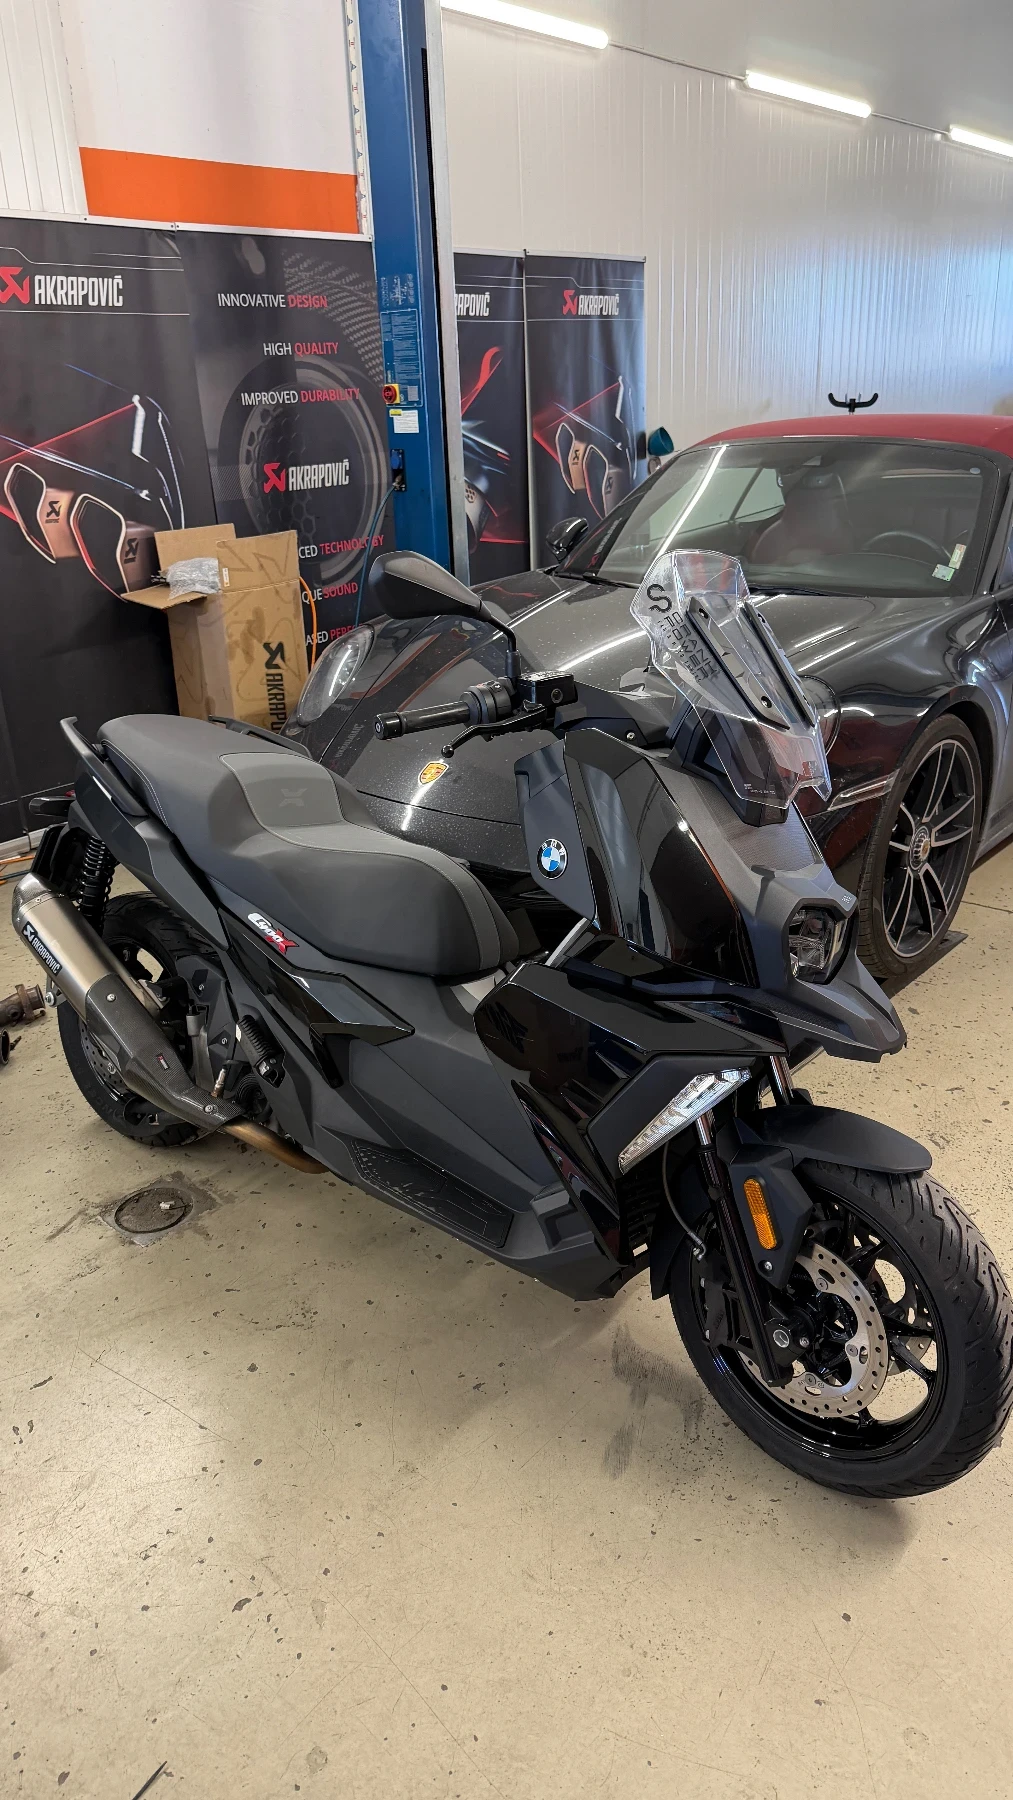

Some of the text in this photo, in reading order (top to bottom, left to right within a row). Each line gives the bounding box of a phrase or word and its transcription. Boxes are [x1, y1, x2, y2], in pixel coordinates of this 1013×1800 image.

[34, 275, 123, 307] AKRAPOVIČ
[217, 293, 328, 309] INNOVATIVE DESIGN
[578, 293, 620, 316] AKRAPOVIČ
[263, 341, 339, 358] HIGH QUALITY
[240, 387, 360, 406] IMPROVED DURABILITY
[288, 458, 350, 492] AKRAPOVIČ
[323, 582, 359, 599] SOUND
[663, 615, 709, 679] POWER
